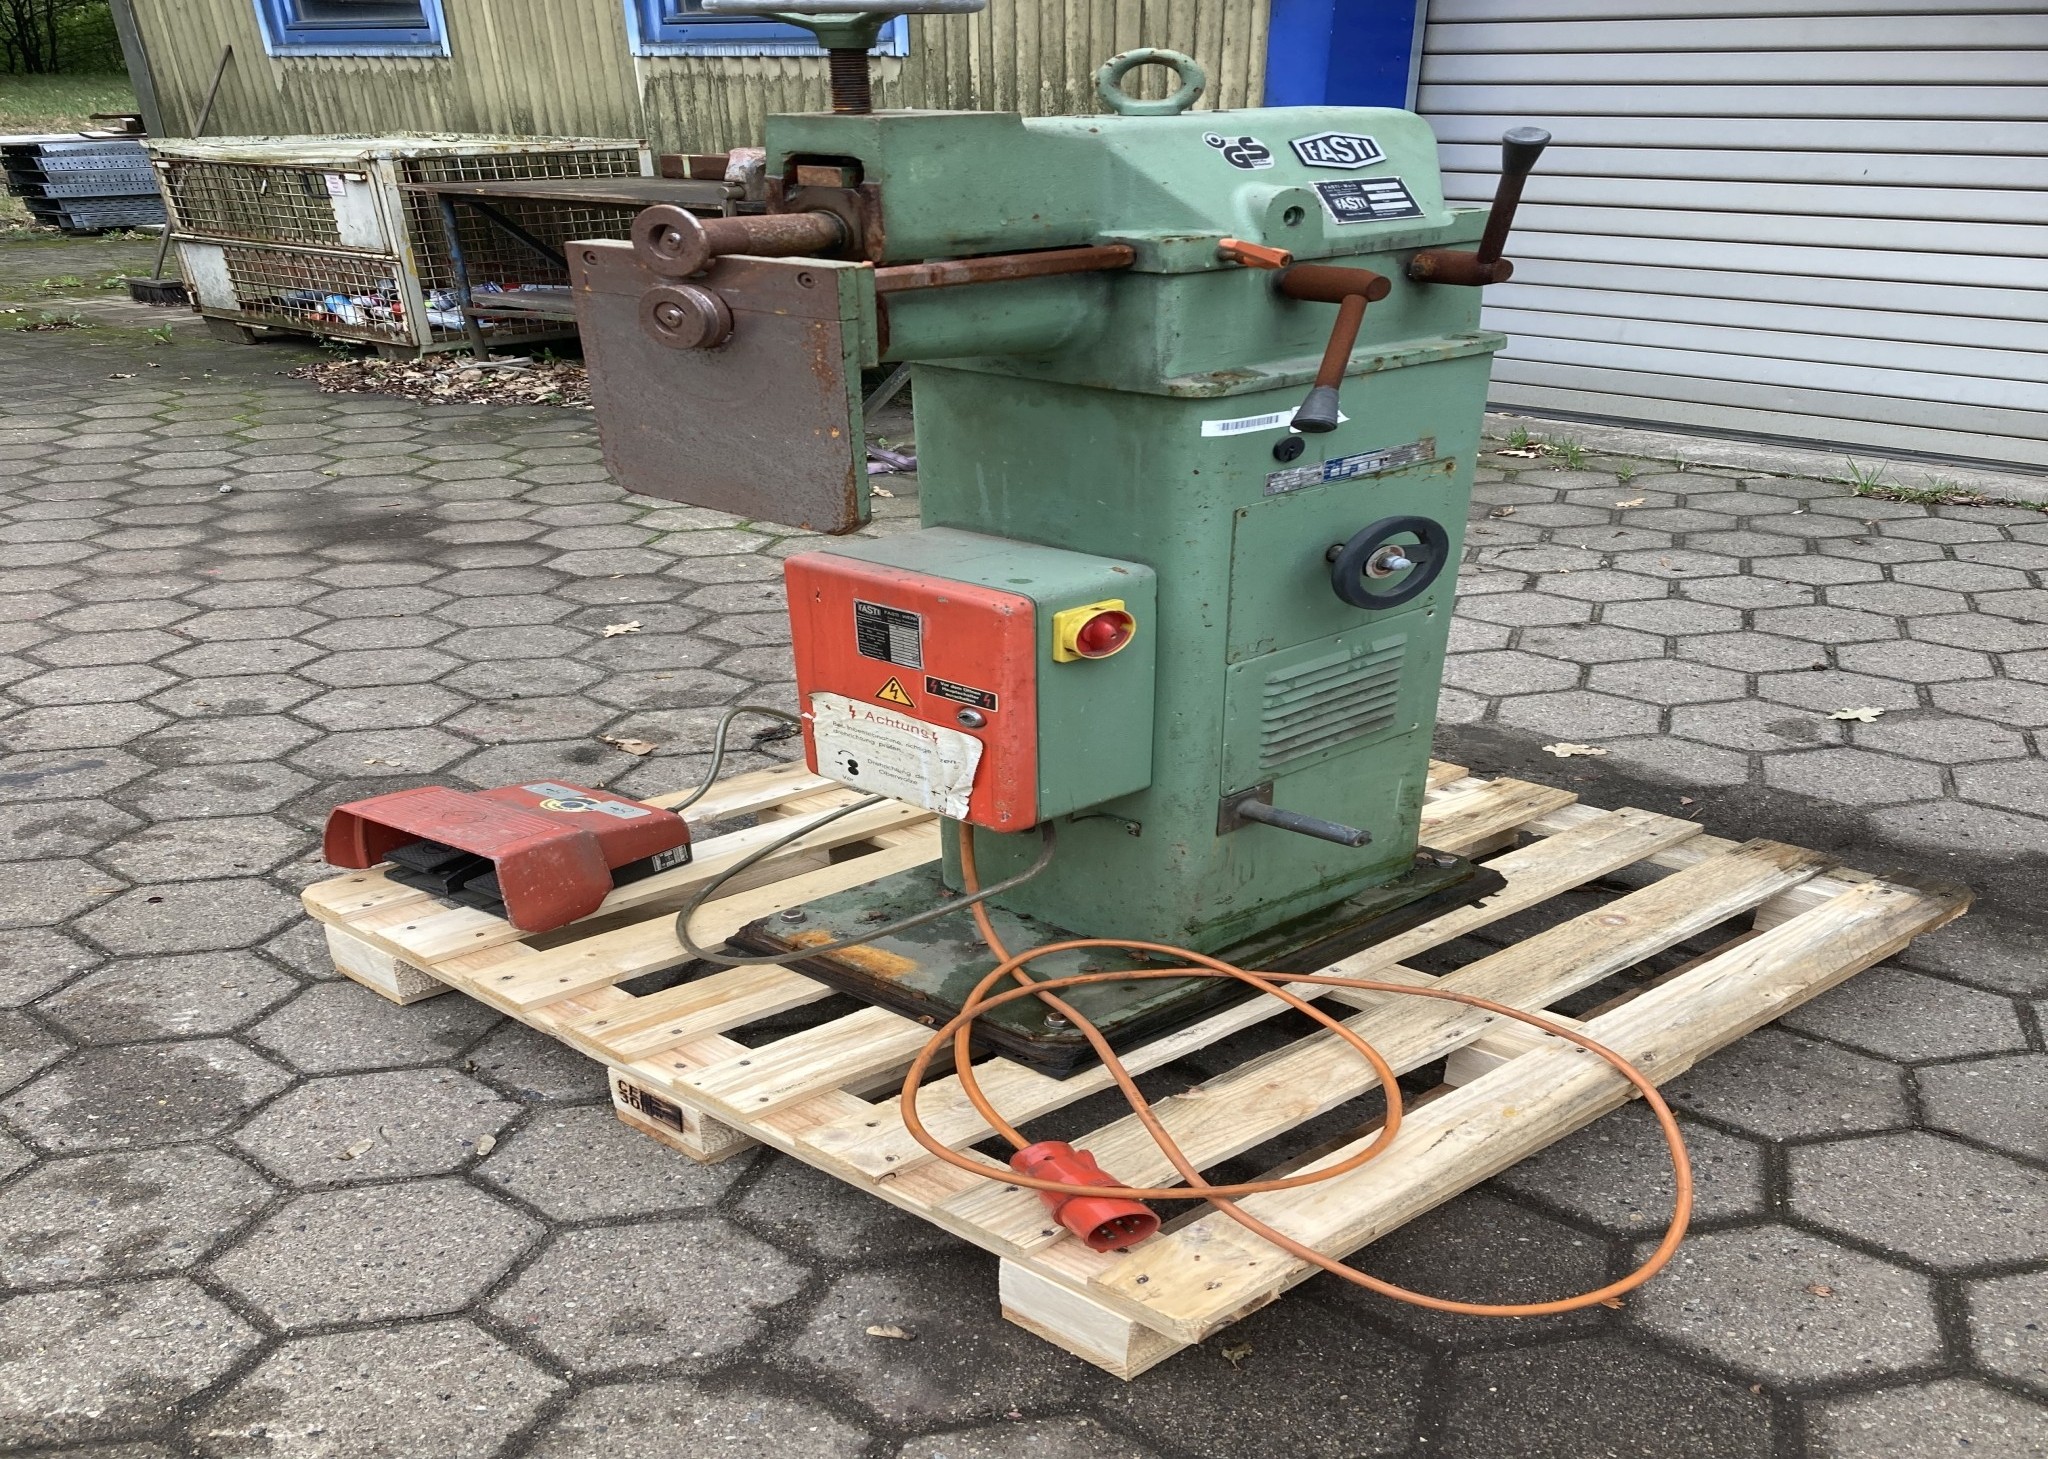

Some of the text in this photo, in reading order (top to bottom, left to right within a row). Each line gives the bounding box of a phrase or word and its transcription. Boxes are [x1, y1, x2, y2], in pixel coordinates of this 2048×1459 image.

[1304, 136, 1376, 163] FASTI
[1333, 196, 1368, 210] FASTI
[864, 711, 929, 739] Achtung
